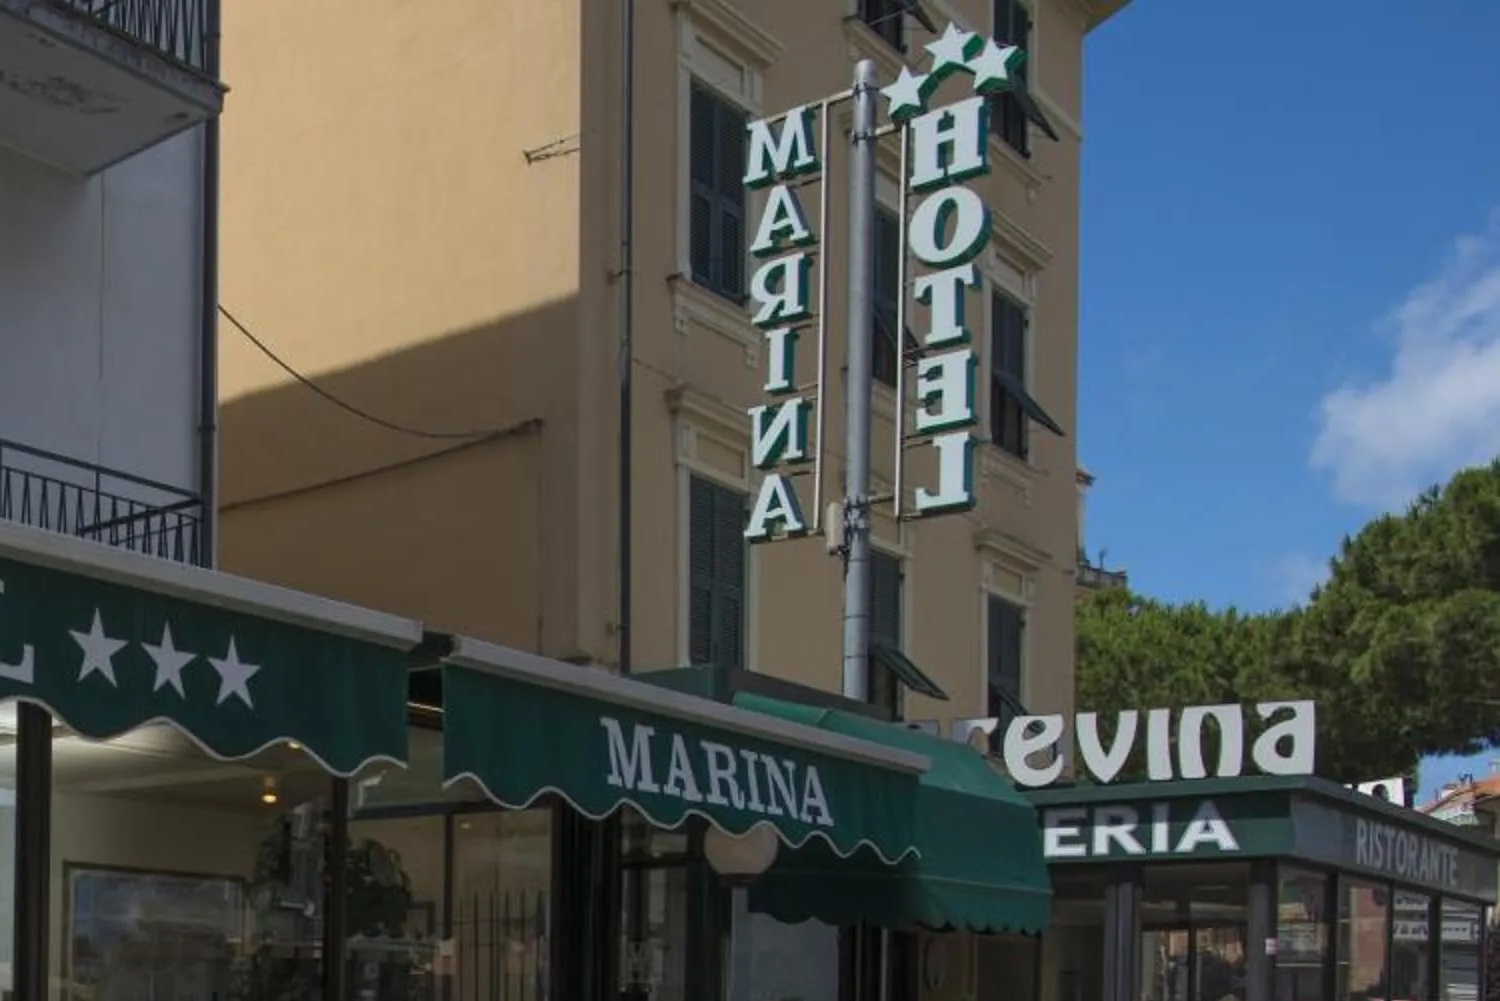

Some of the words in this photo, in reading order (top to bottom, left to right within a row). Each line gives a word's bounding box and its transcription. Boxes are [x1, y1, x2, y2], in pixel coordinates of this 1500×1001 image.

[600, 716, 835, 827] MARINA
[1043, 800, 1241, 858] ERIA
[1356, 817, 1459, 888] RISTORANTE
